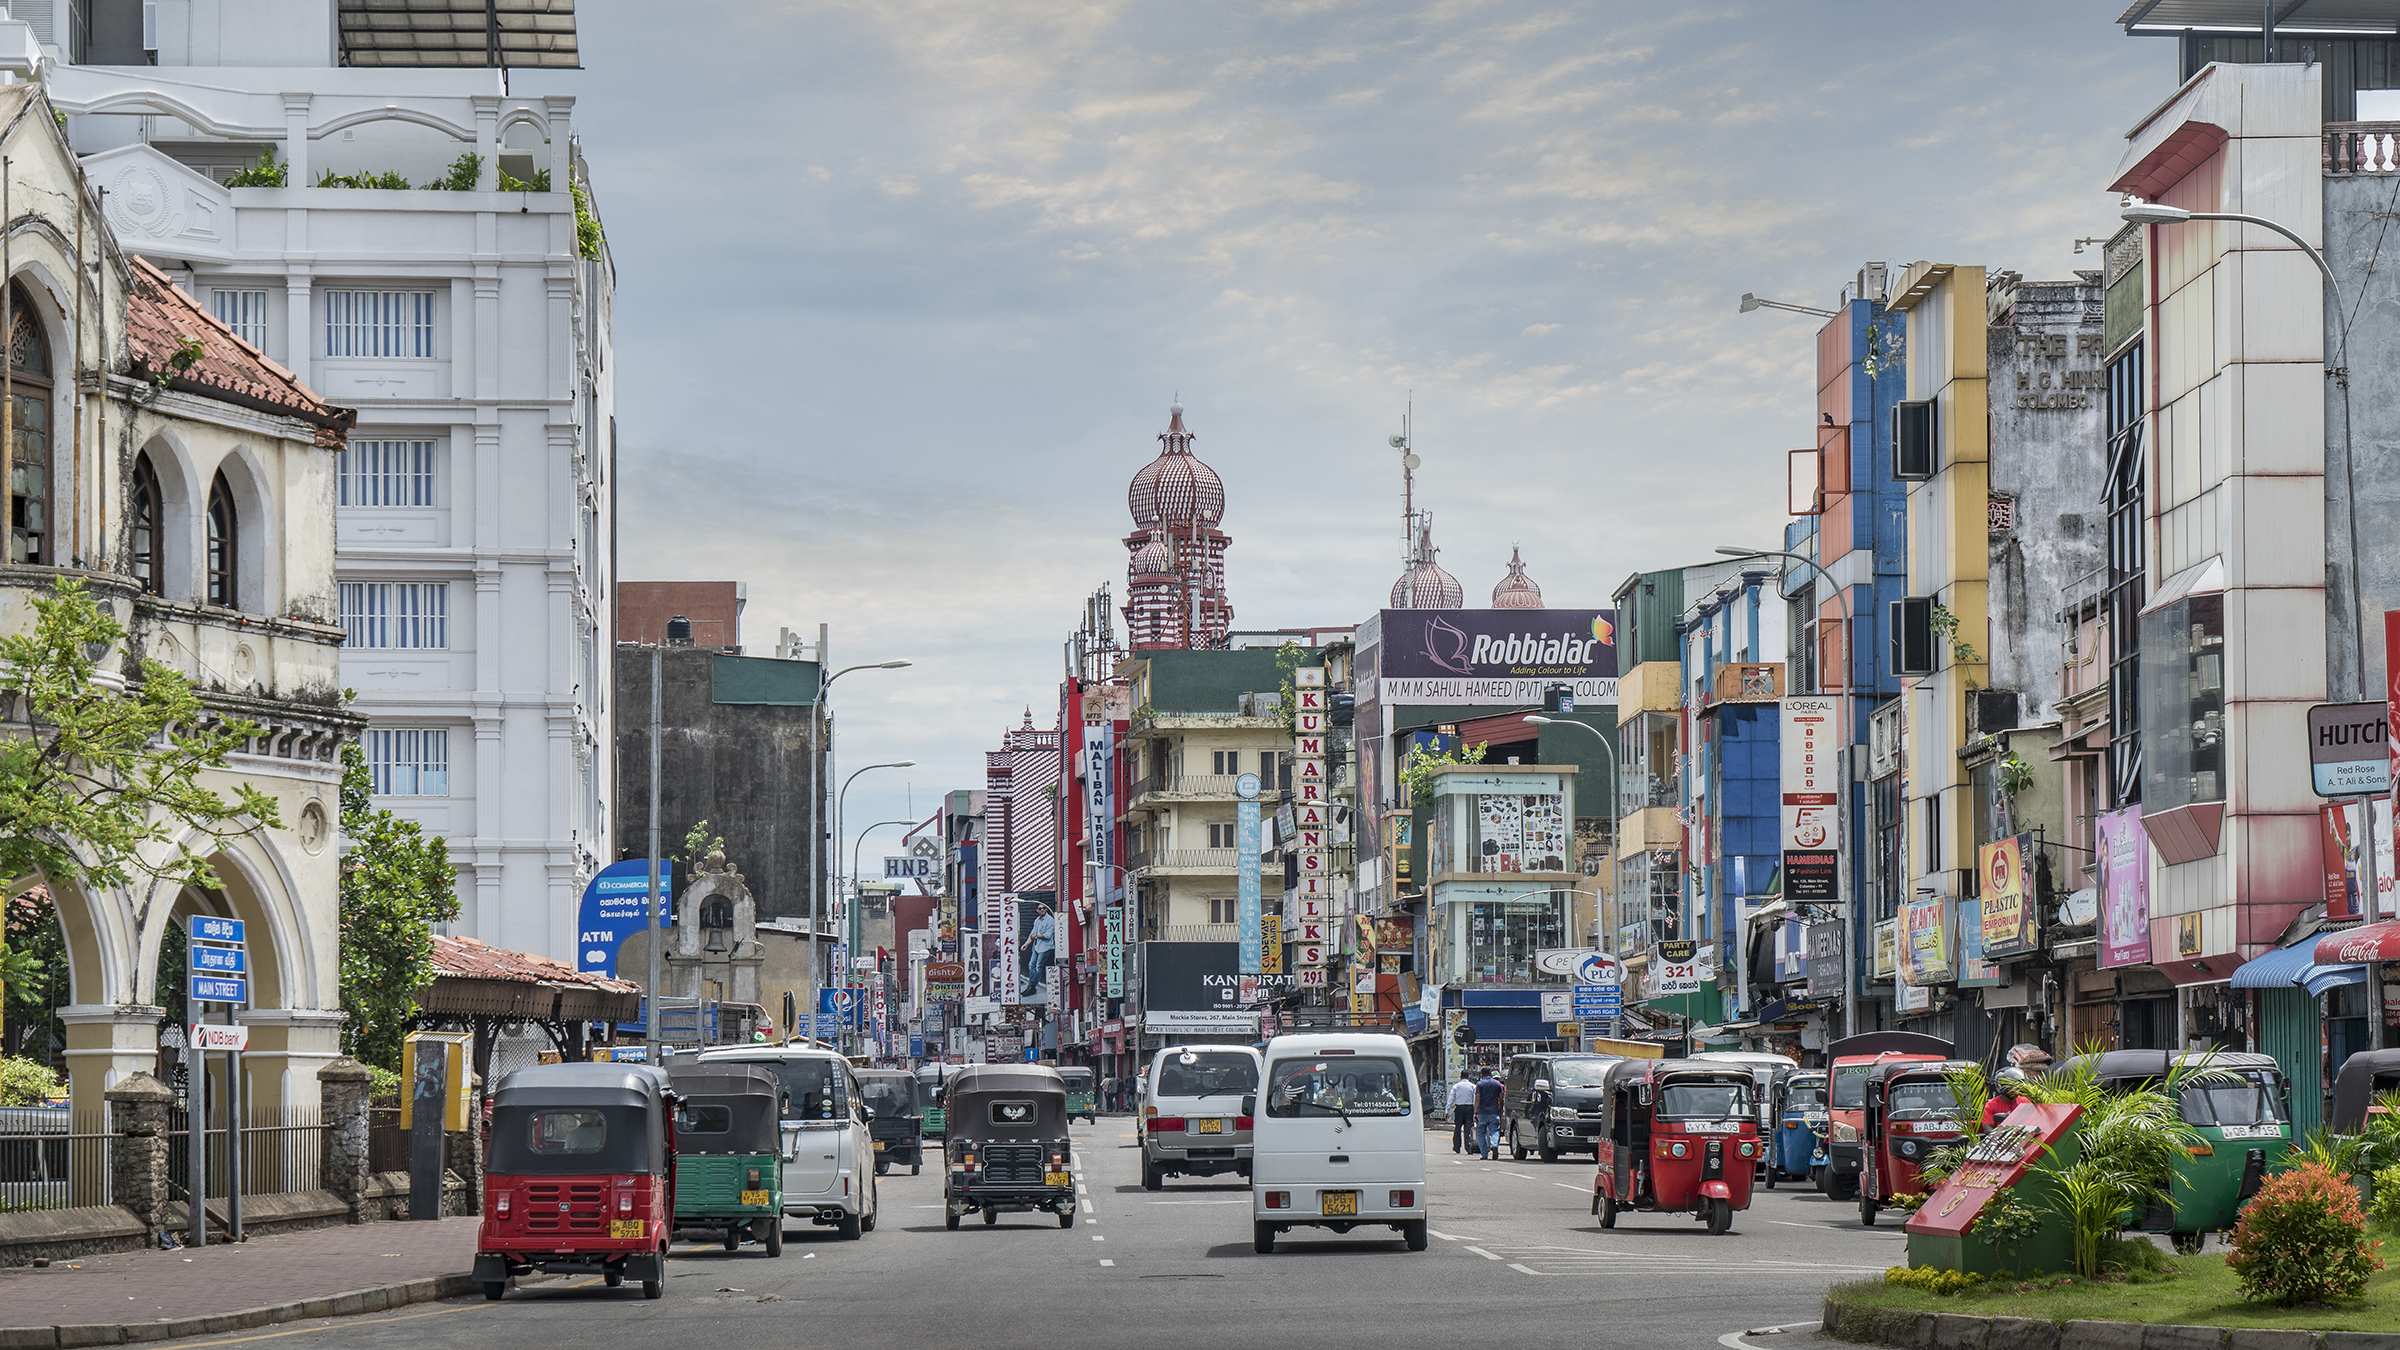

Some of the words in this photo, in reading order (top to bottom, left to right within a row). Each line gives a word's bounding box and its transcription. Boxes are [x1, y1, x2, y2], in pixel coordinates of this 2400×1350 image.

[2017, 334, 2067, 357] THE
[1471, 632, 1598, 665] Robbialac
[1510, 667, 1536, 676] Adding
[1538, 666, 1562, 675] Colour
[1564, 667, 1571, 675] to
[1573, 666, 1587, 675] Life
[1387, 682, 1398, 697] M
[1400, 682, 1410, 697] M
[1412, 682, 1423, 697] M
[1426, 681, 1462, 697] SAHUL
[1465, 681, 1512, 697] HAMEED
[1515, 680, 1543, 700] (PVT)
[1576, 681, 1619, 697] COLOM
[1786, 701, 1832, 710] L'ORÉAL
[1090, 741, 1103, 806] MALIBAN
[2337, 766, 2352, 774] Red
[2355, 765, 2375, 773] Rose
[2346, 777, 2356, 785] Ali
[2358, 777, 2364, 785] &
[2366, 776, 2386, 784] Sons
[1787, 855, 1834, 864] HAMEEDIAS
[886, 859, 929, 876] HNB
[611, 881, 649, 889] COMMERCIAL
[2377, 871, 2395, 893] alo
[1983, 893, 2019, 916] PLASTIC
[1984, 914, 2018, 931] EMPORIUM
[581, 931, 613, 942] ATM
[1261, 919, 1270, 968] CAUSEWAY
[1360, 917, 1371, 960] MUNA
[1913, 931, 1938, 951] VILLAS
[1109, 922, 1120, 982] MACKI
[1303, 971, 1323, 985] 291
[1591, 969, 1615, 979] PLC
[1665, 965, 1693, 978] 321
[198, 981, 214, 996] MAIN
[215, 982, 238, 997] STREET
[208, 1030, 224, 1045] NDB
[225, 1031, 239, 1046] bank
[1717, 1123, 1738, 1131] 3495
[1923, 1123, 1941, 1131] ABJ
[1333, 1194, 1346, 1203] PG
[1943, 1192, 1965, 1213] 3
[1327, 1204, 1352, 1214] 5421
[622, 1221, 639, 1229] ABQ
